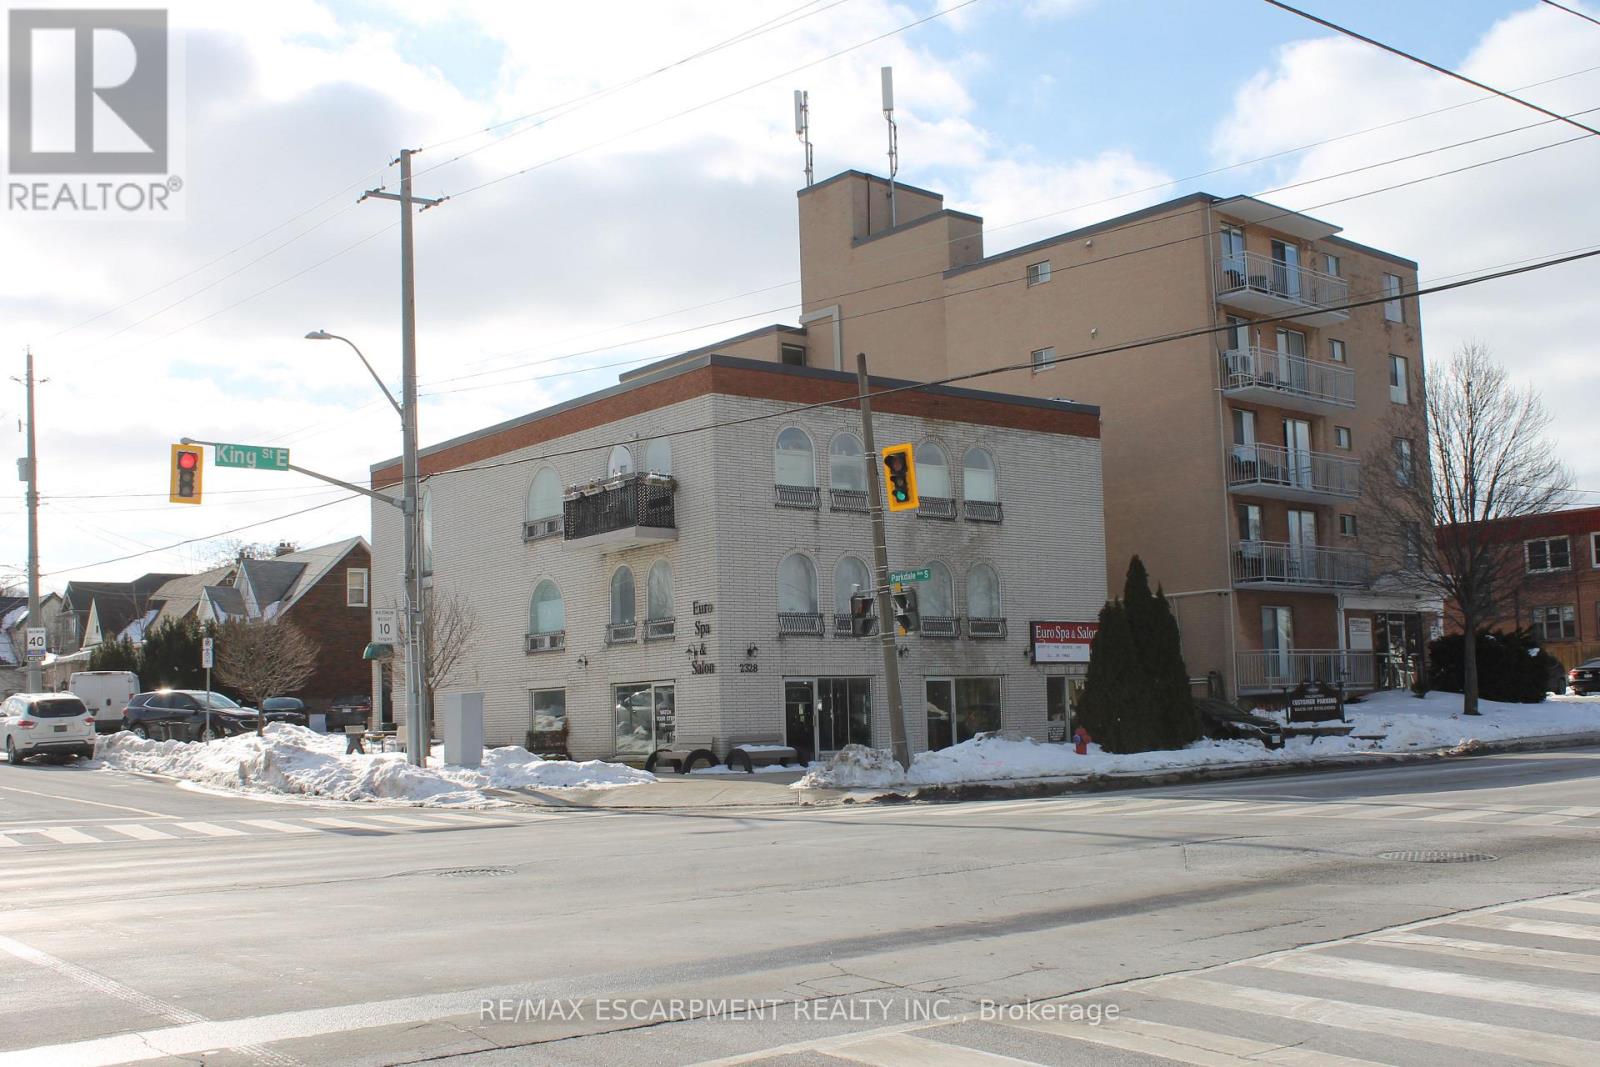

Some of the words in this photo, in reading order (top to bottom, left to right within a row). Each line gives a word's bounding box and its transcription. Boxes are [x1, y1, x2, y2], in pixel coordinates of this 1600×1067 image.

[215, 444, 257, 469] King
[276, 449, 288, 466] E
[891, 572, 916, 582] Parkdale
[923, 569, 929, 579] S
[693, 601, 713, 615] Euro
[379, 623, 391, 635] 10
[694, 620, 710, 638] Spa
[1035, 625, 1055, 639] Euro
[1055, 625, 1070, 642] Spa
[29, 636, 44, 647] 40
[699, 643, 707, 655] &
[691, 660, 715, 675] Salon
[739, 663, 759, 673] 2328
